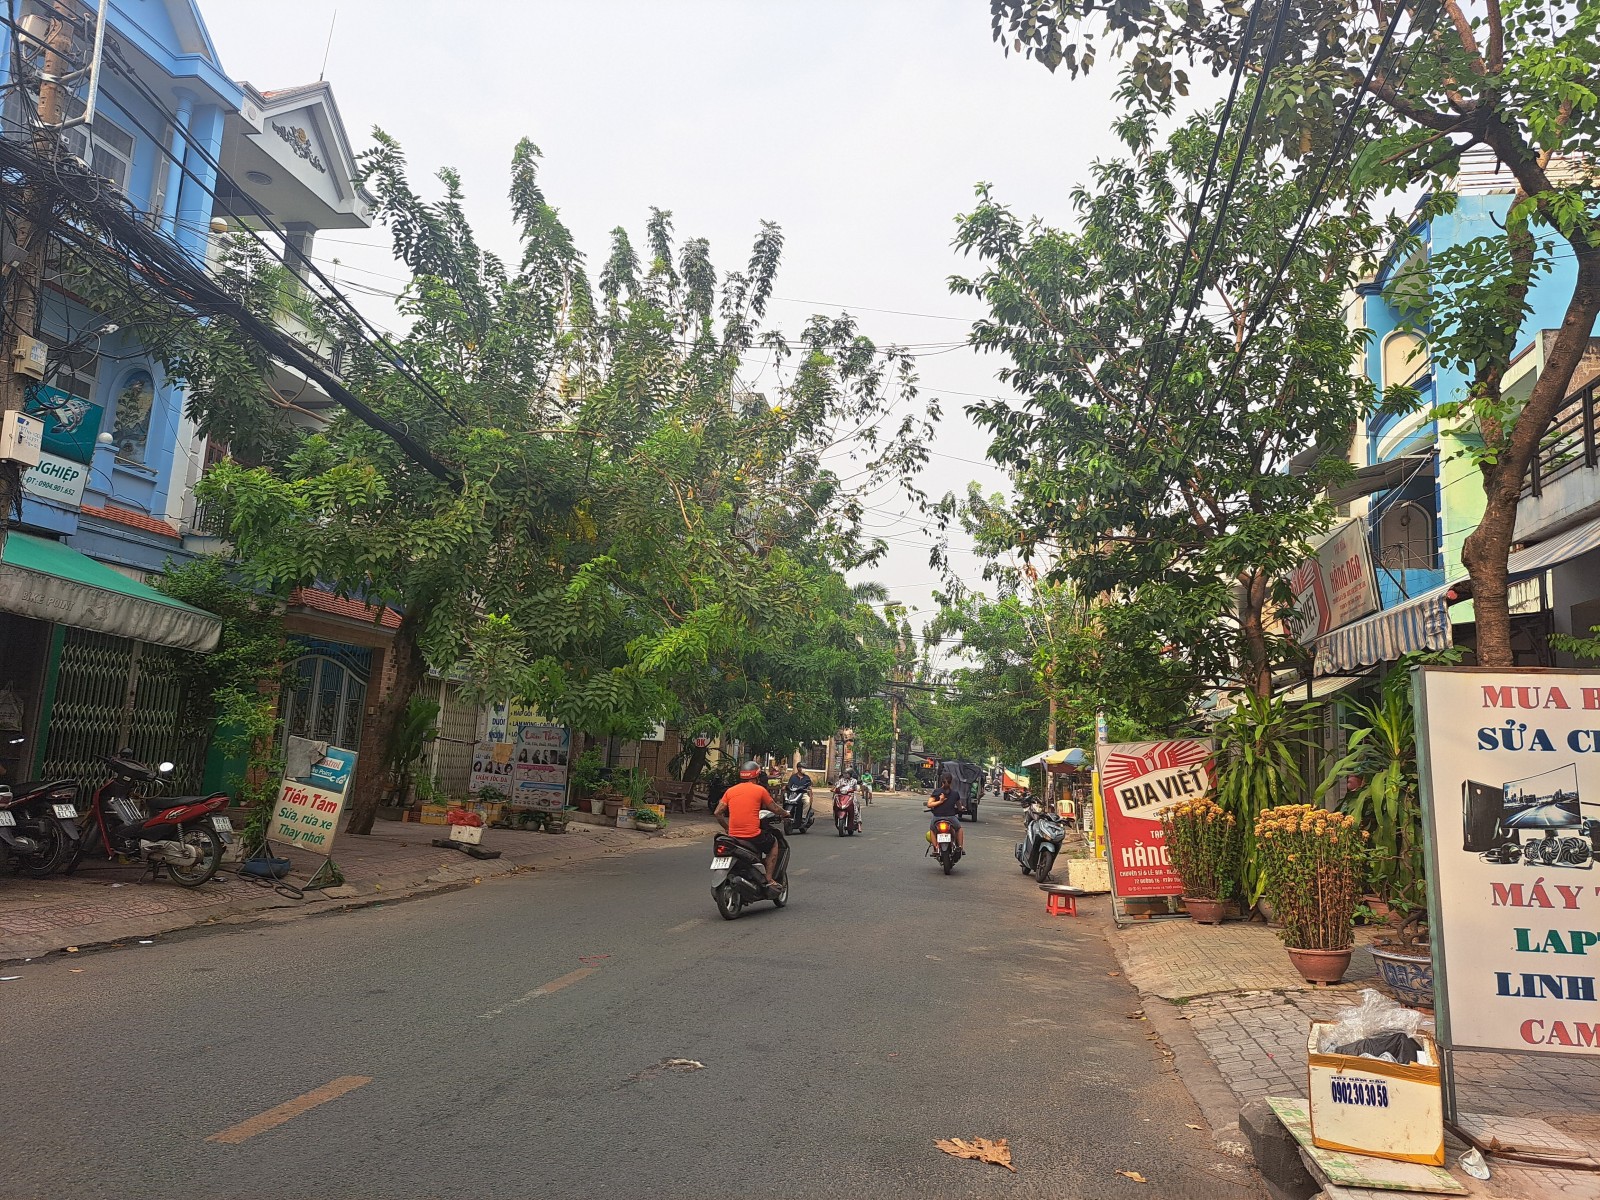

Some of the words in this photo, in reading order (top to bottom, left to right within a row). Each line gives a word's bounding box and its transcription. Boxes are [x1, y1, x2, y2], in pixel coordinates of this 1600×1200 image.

[46, 597, 75, 611] POINT
[1481, 685, 1572, 710] MUA
[1477, 719, 1557, 751] SỬA
[282, 786, 309, 807] Tiến
[310, 793, 338, 813] Tám
[1120, 782, 1161, 811] BIA
[1156, 769, 1204, 799] VIỆT
[278, 824, 302, 840] Thay
[319, 820, 333, 830] xe
[1490, 877, 1583, 910] MÁY
[1513, 928, 1600, 956] LAP
[1494, 971, 1598, 1002] LINH
